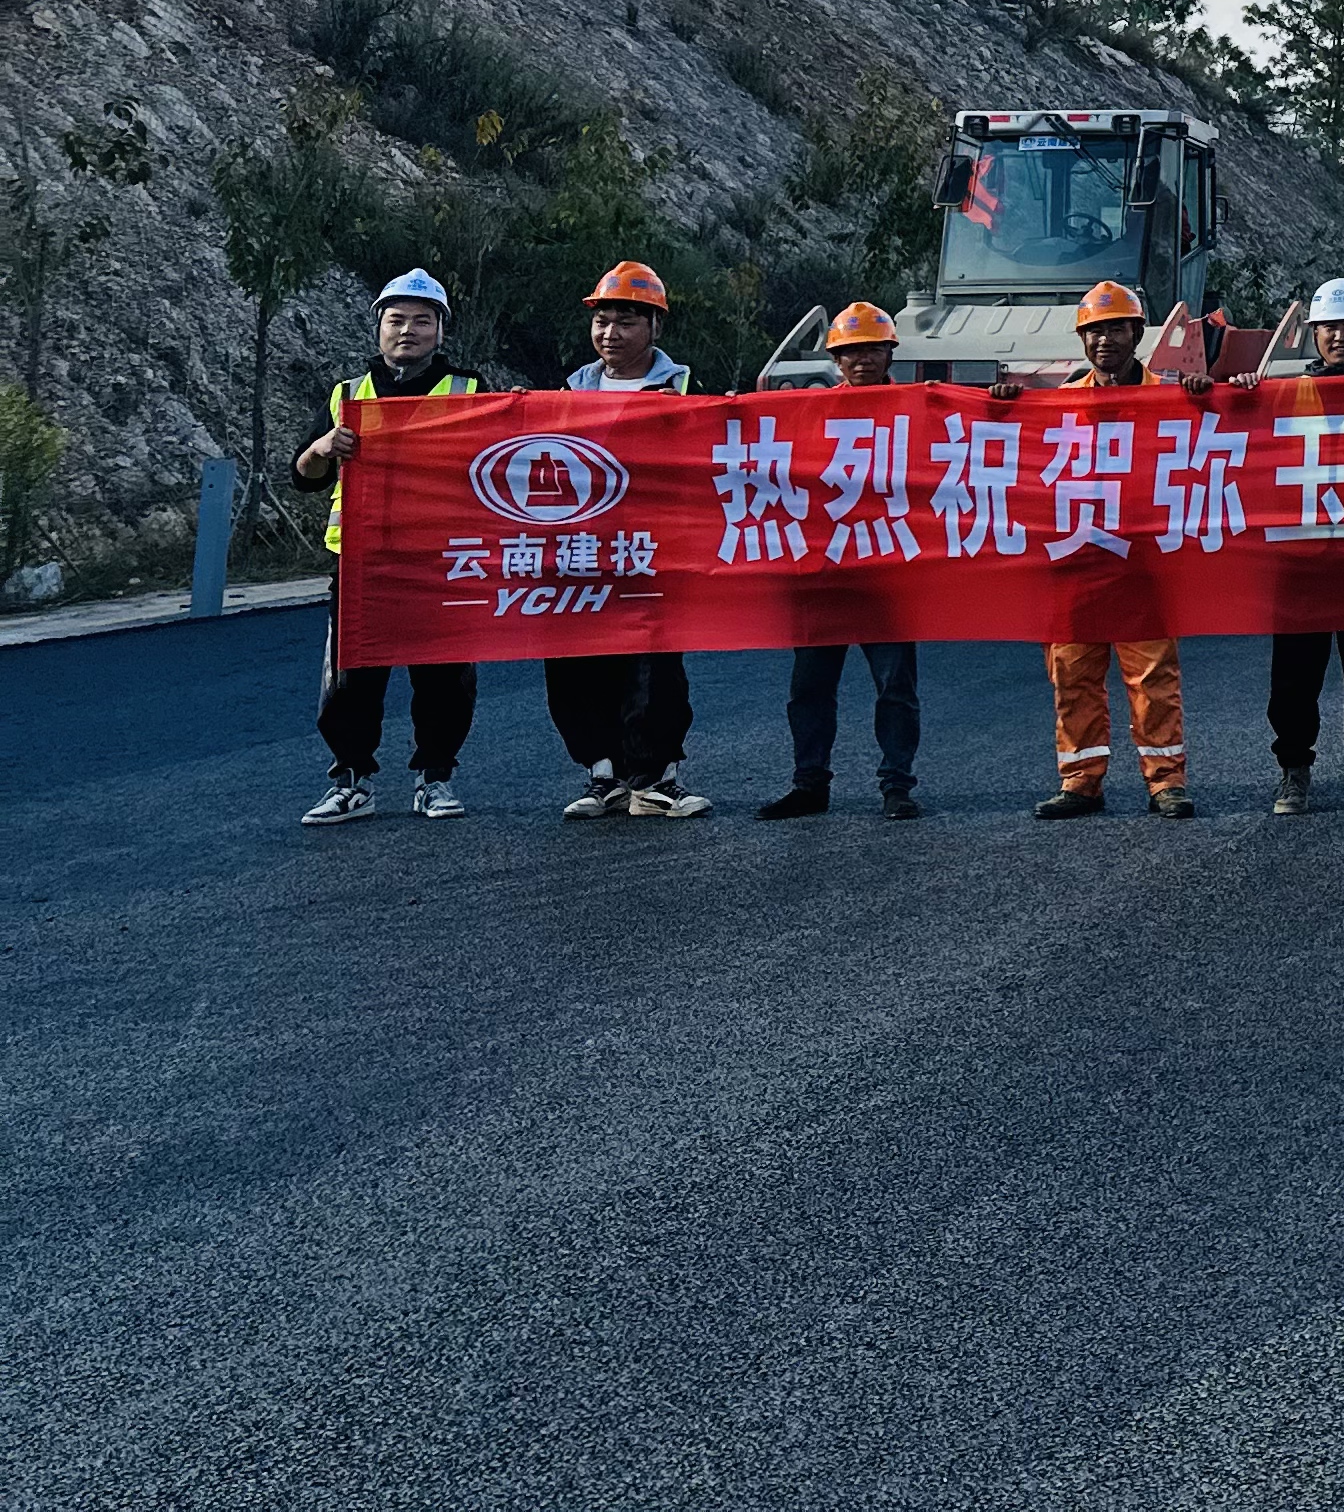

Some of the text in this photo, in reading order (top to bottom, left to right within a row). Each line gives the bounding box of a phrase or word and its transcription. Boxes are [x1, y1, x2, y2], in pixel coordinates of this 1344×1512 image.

[442, 530, 659, 581] 云南建投
[493, 584, 614, 617] YCIH
